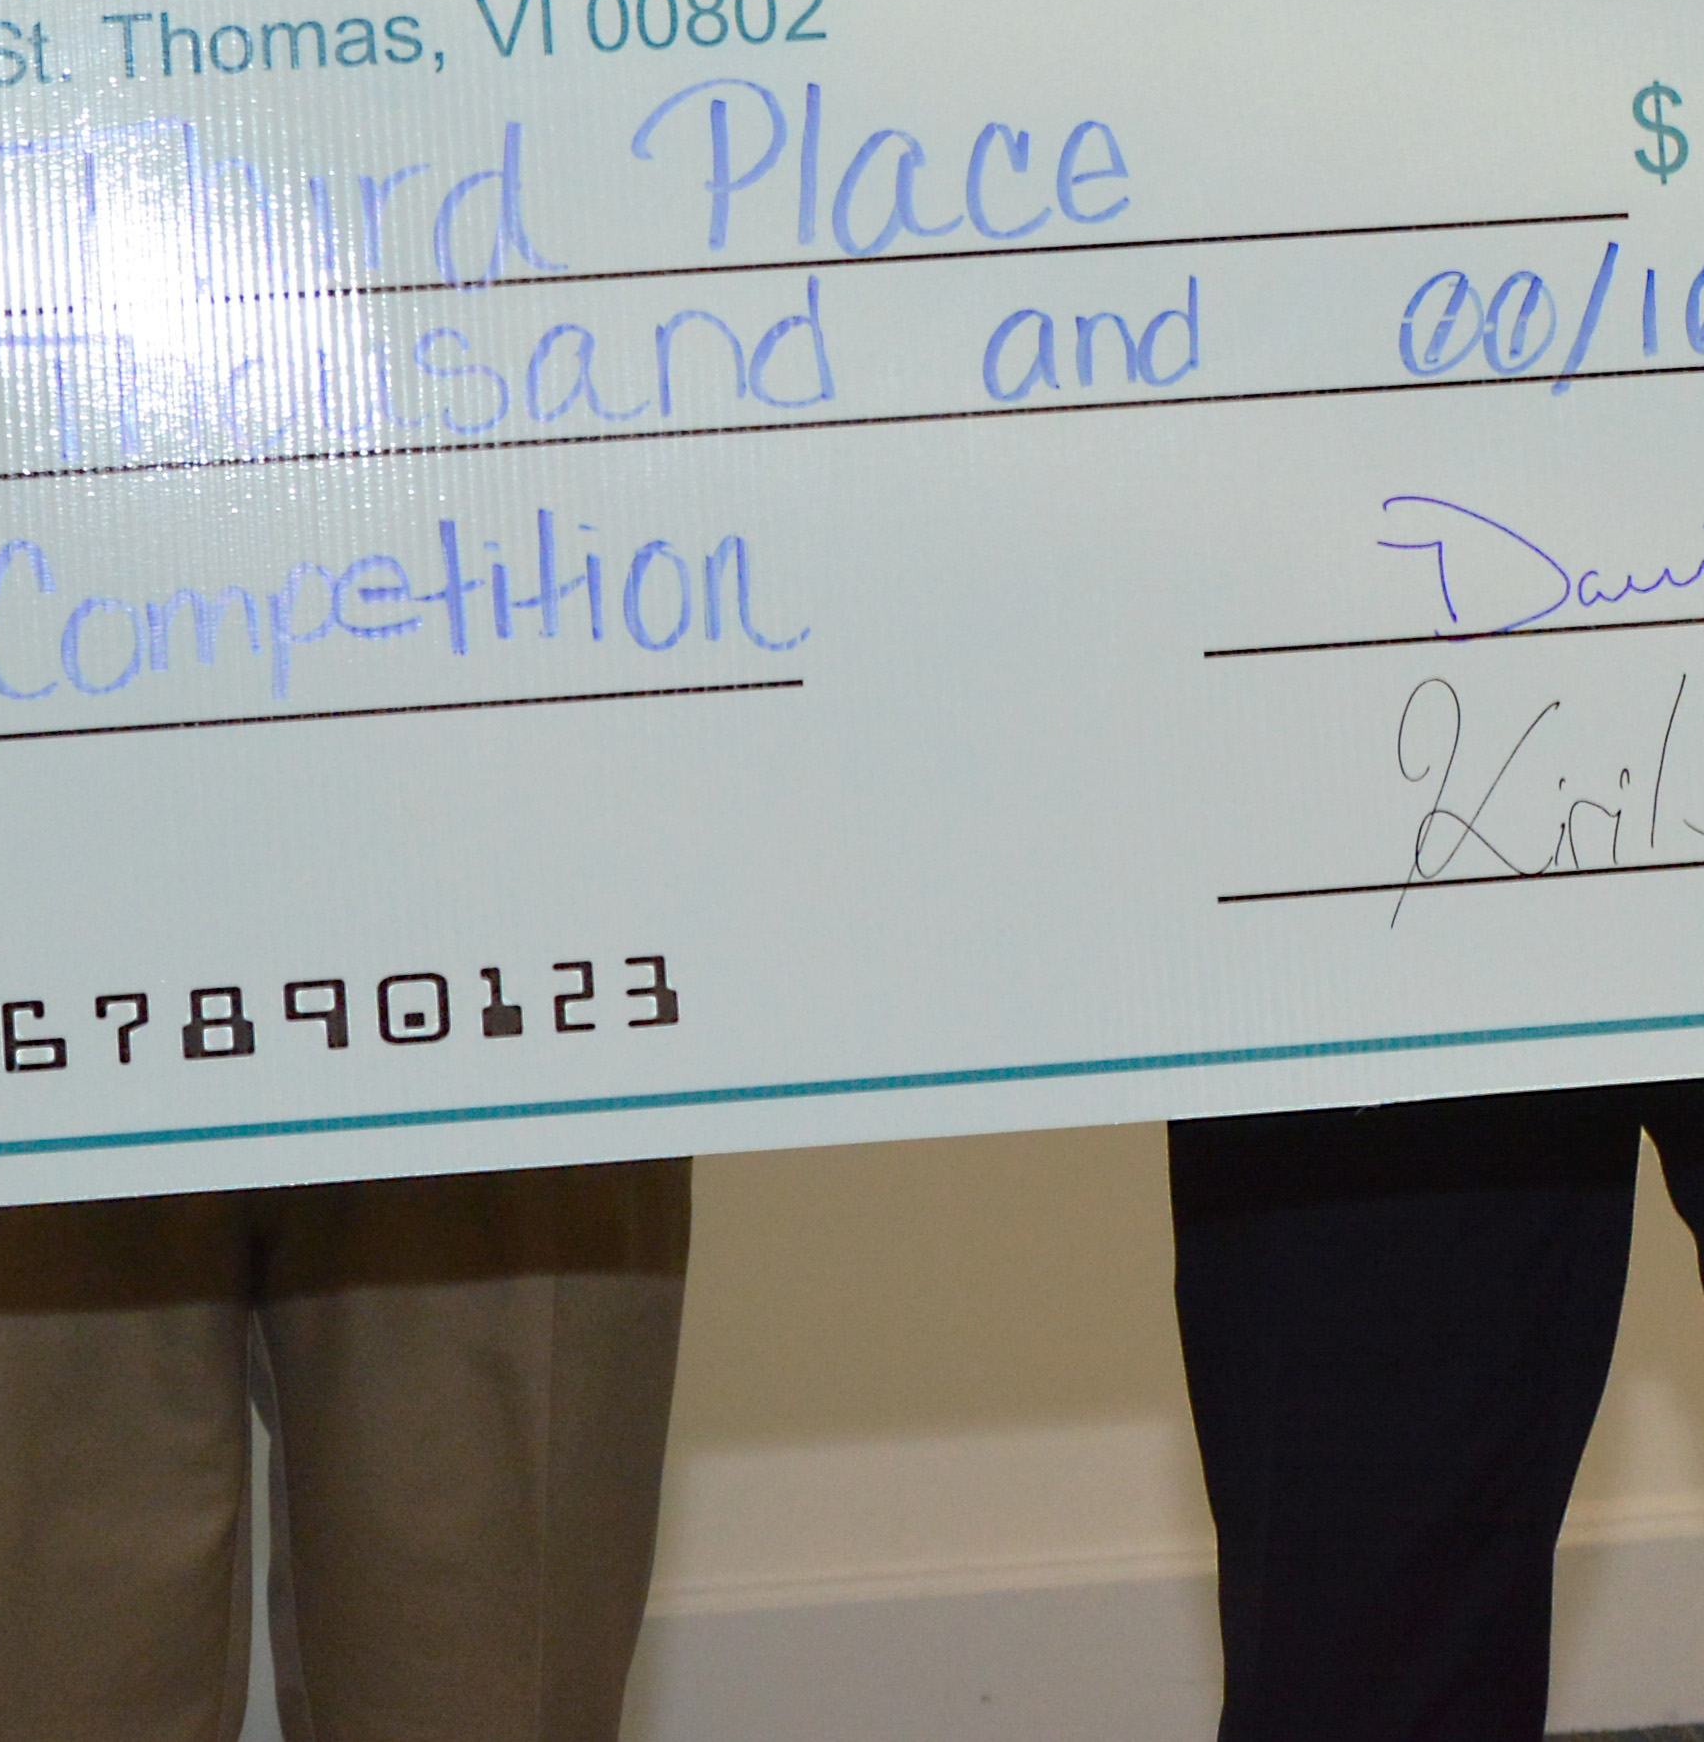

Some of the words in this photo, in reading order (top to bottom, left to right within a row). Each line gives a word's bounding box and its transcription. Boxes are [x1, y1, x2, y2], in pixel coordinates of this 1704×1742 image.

[102, 4, 447, 80] Thomas,
[632, 77, 1134, 259] Place
[1632, 80, 1691, 186] $
[980, 274, 1201, 403] and
